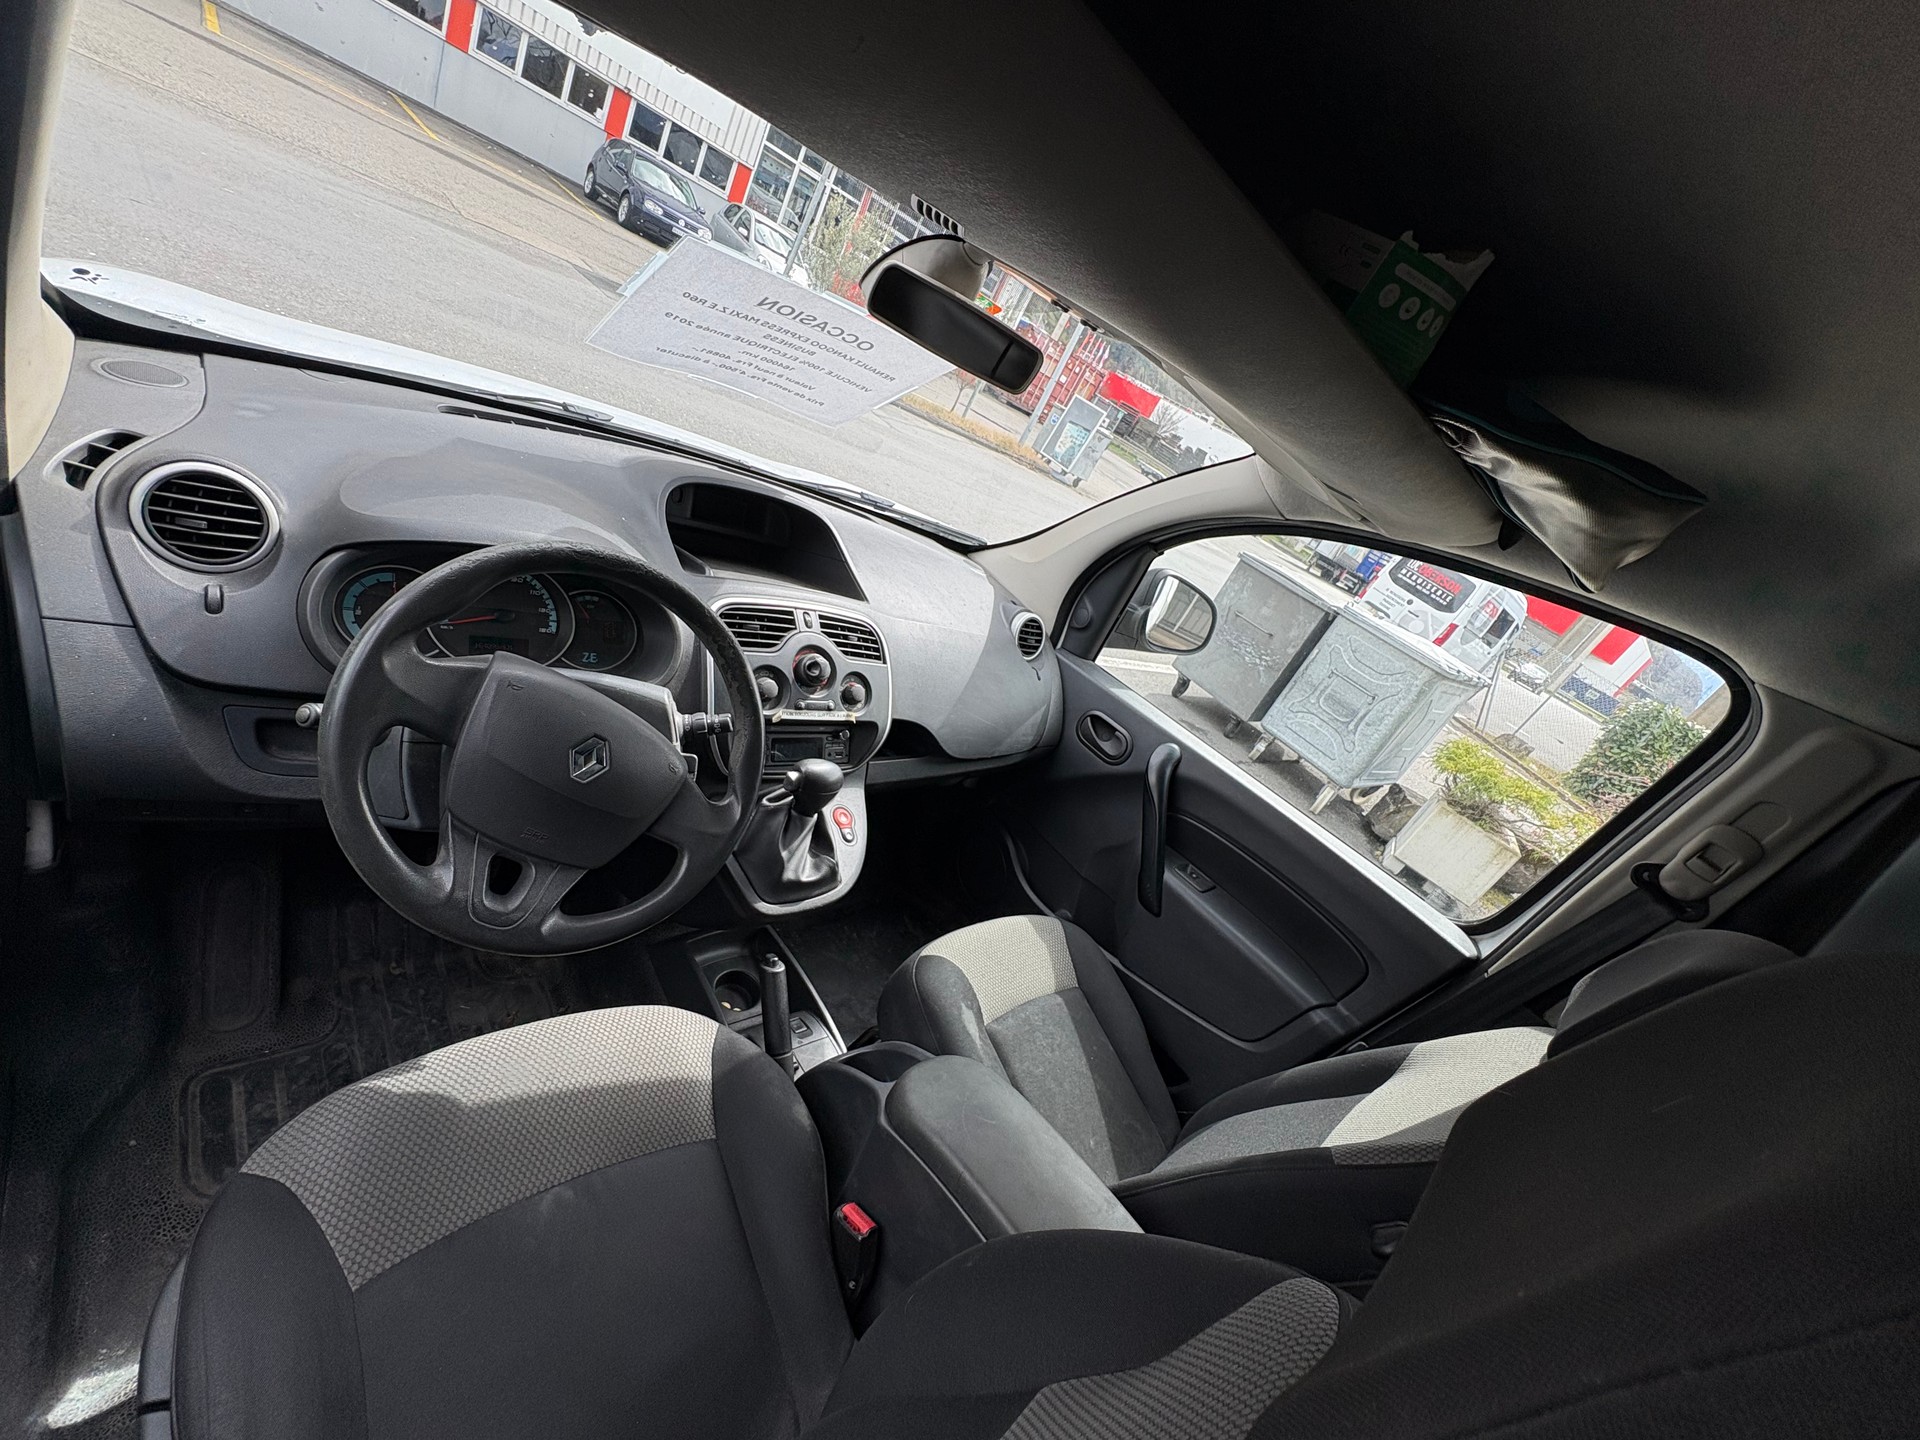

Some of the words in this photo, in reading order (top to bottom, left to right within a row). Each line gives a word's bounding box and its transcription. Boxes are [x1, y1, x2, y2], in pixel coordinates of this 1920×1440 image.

[1400, 568, 1453, 602] MENUISERIE
[1407, 559, 1424, 571] LUC
[1417, 563, 1462, 594] OBERSON
